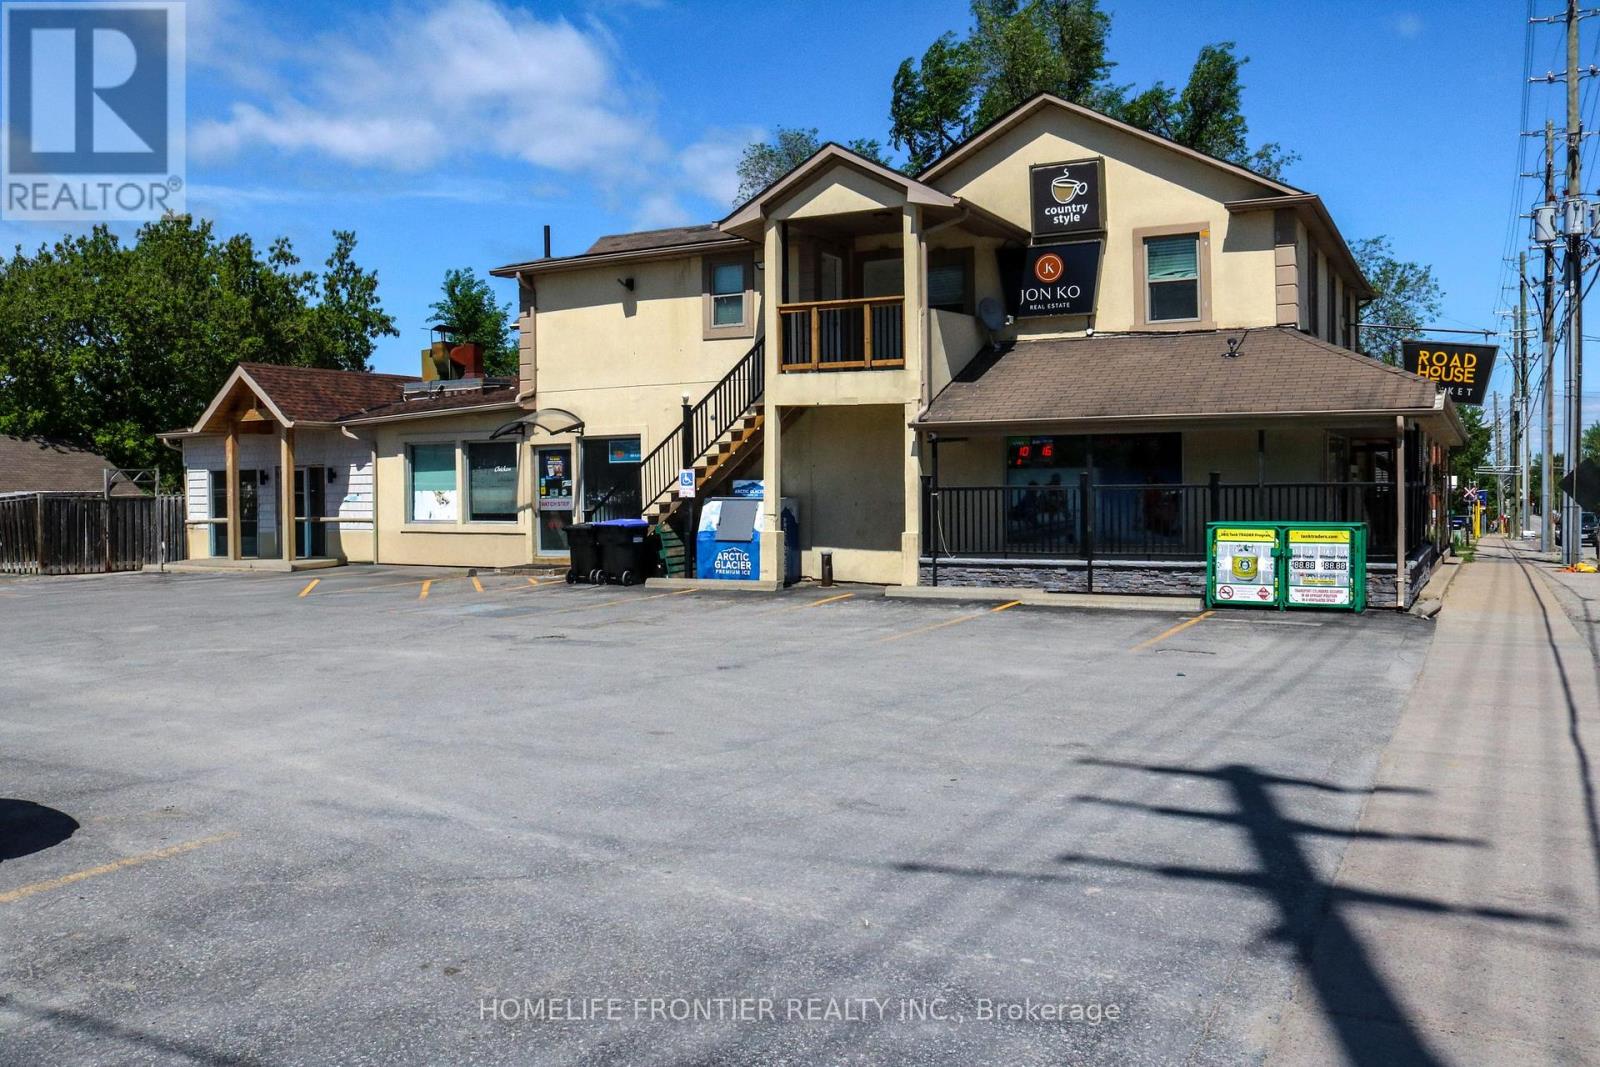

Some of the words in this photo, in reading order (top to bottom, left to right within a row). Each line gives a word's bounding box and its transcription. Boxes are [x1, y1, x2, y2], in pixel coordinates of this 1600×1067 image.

[1045, 203, 1088, 216] country
[1053, 214, 1081, 225] style
[1020, 287, 1051, 305] JON
[1057, 285, 1081, 299] KO
[1030, 302, 1046, 311] REAL
[1047, 301, 1071, 310] ESTATE
[1418, 350, 1477, 368] ROAD
[1417, 365, 1476, 383] HOUSE
[1447, 387, 1473, 396] KET
[717, 552, 750, 561] ARCTIC
[714, 561, 752, 570] GLACIER
